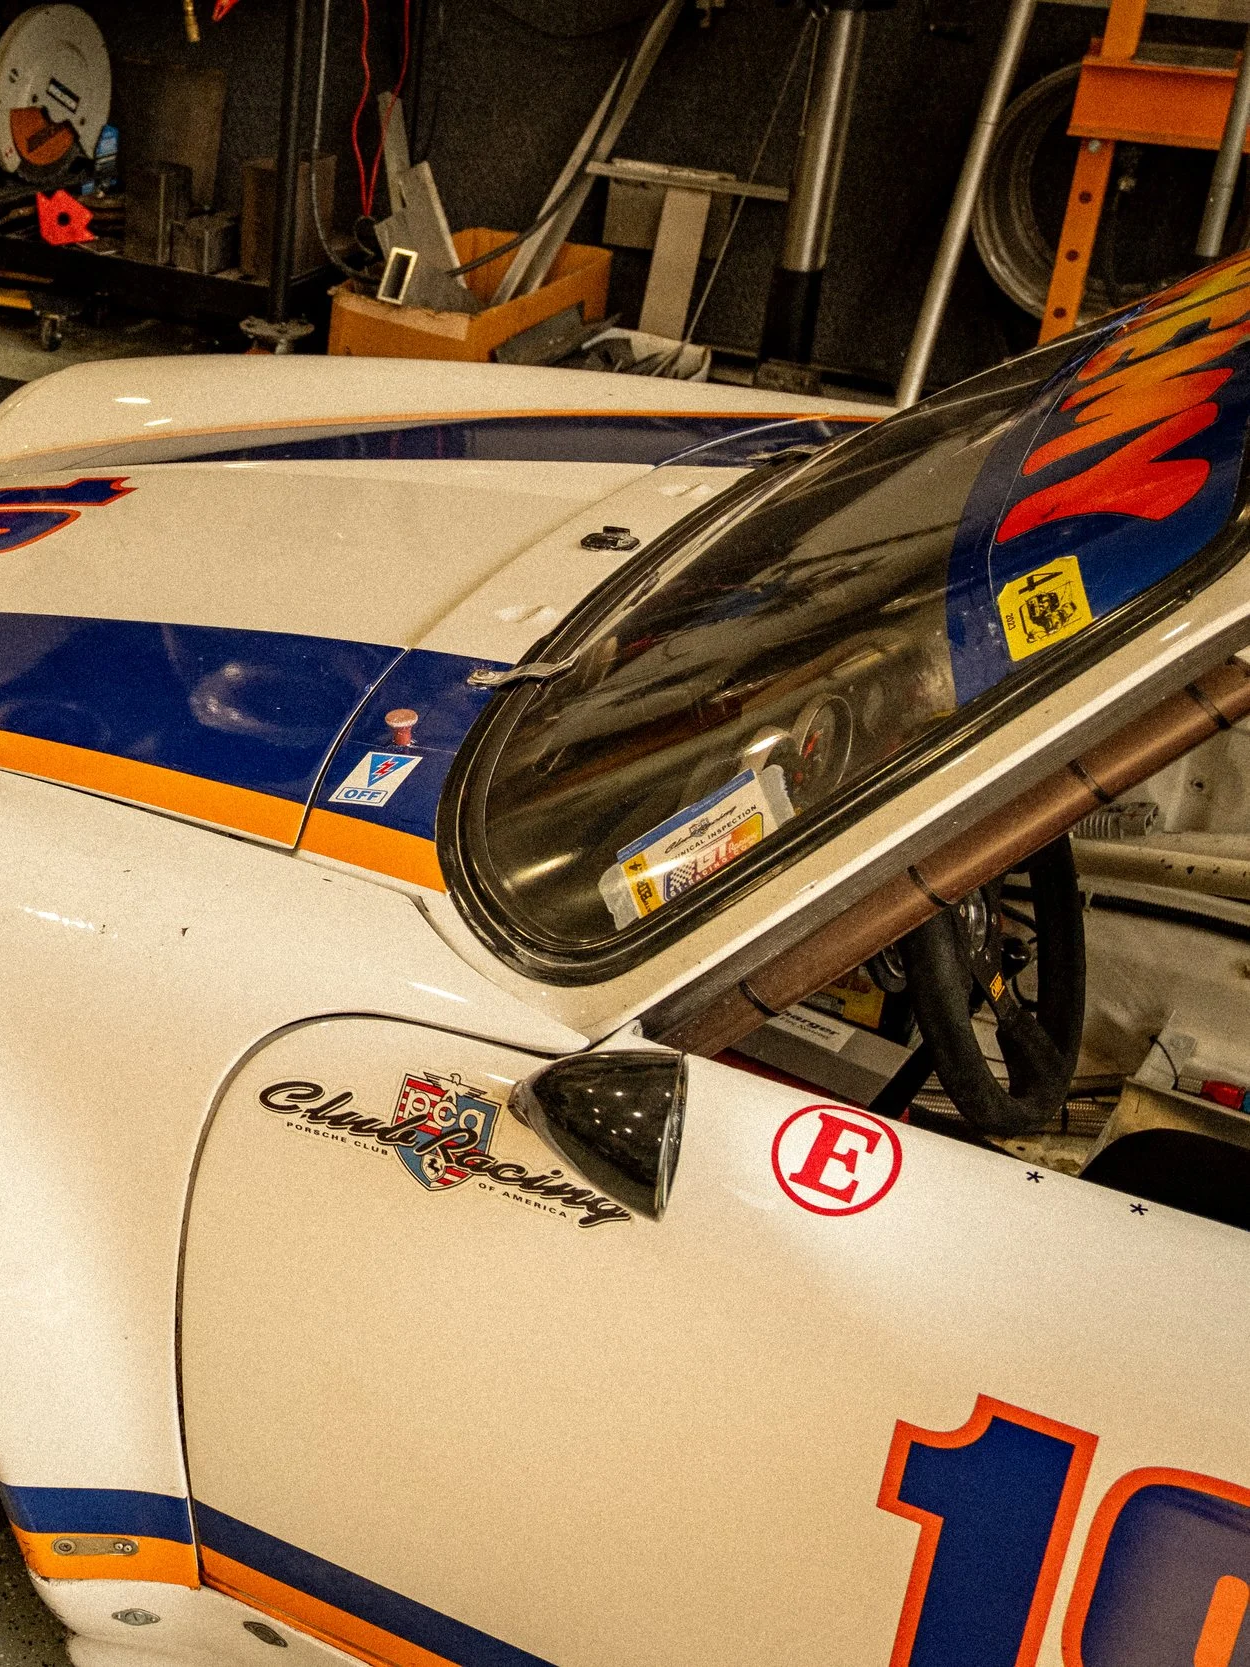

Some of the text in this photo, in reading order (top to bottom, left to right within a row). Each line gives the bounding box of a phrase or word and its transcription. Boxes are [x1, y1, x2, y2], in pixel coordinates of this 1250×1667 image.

[1018, 571, 1063, 595] 4
[1005, 613, 1016, 631] 2023
[344, 789, 382, 801] OFF
[707, 804, 758, 840] INSPECTION
[695, 834, 733, 873] GT
[991, 975, 1003, 998] OMP
[404, 1088, 486, 1136] pca
[259, 1081, 632, 1228] Club Racing
[286, 1121, 567, 1218] PORSCHE CLUB OF AMERICA
[789, 1112, 881, 1204] E
